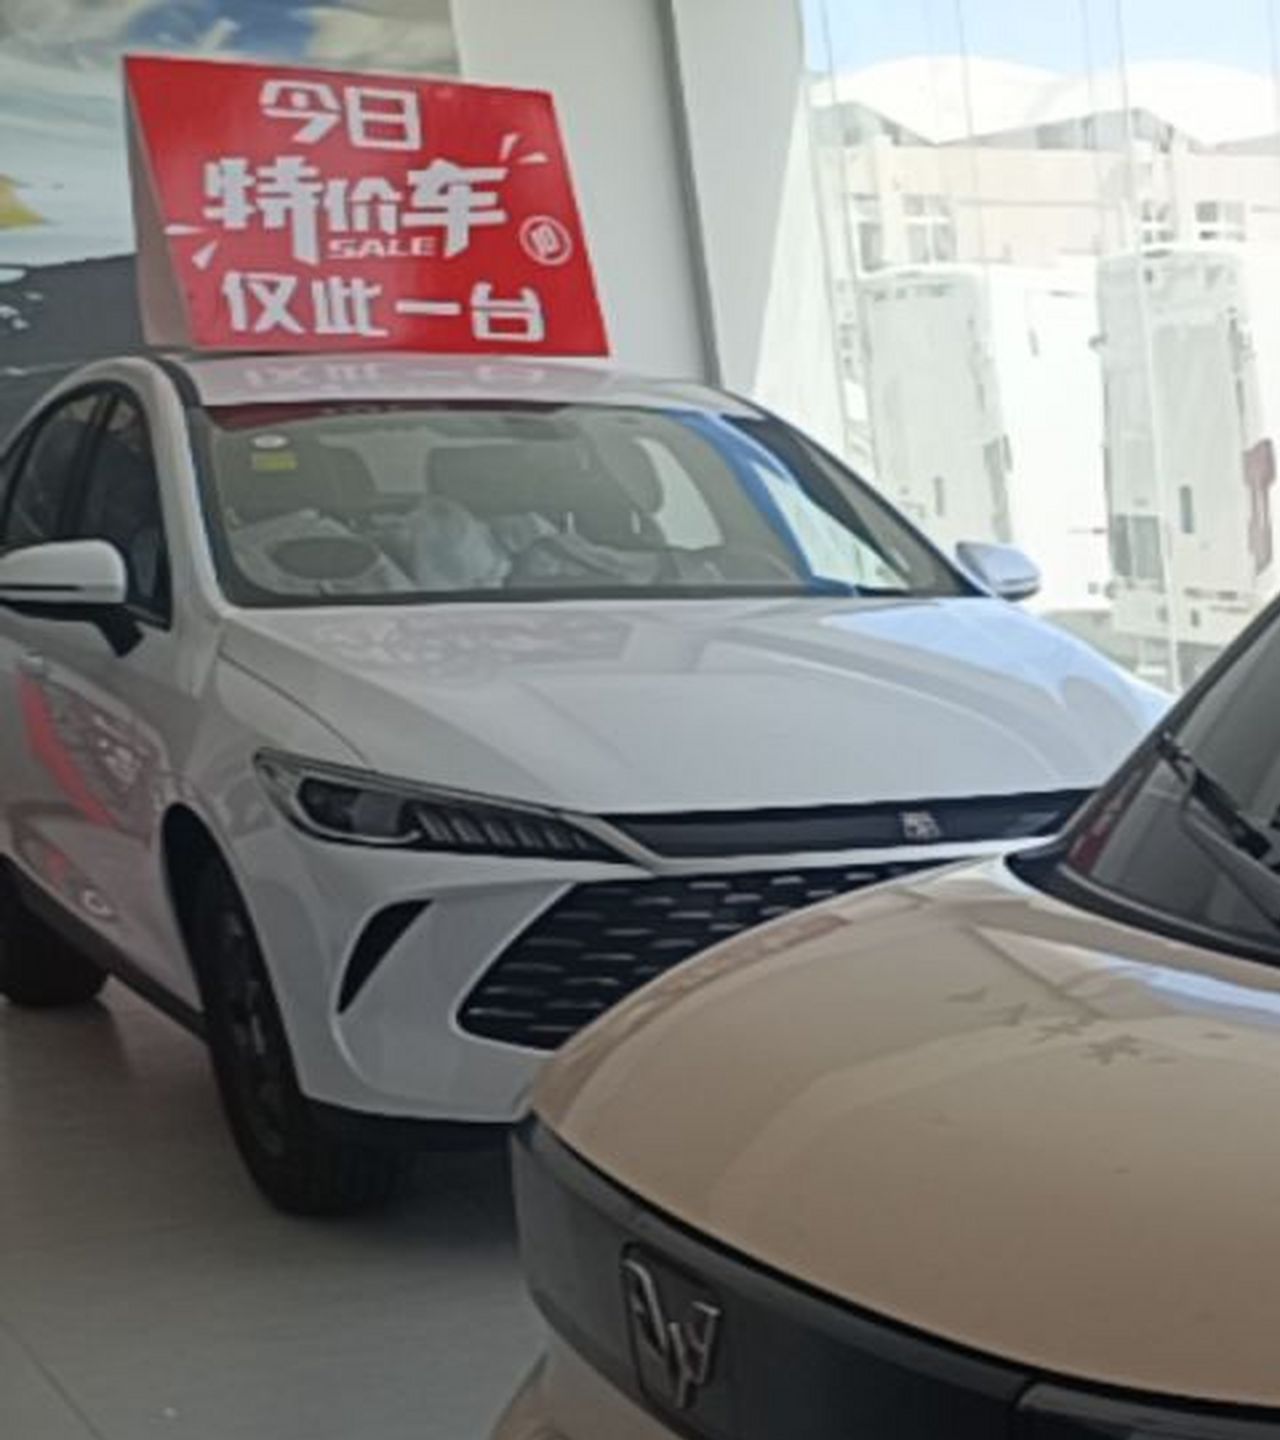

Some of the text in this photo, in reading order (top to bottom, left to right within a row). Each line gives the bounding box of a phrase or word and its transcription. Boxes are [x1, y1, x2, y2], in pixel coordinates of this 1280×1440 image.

[259, 78, 423, 151] 今日
[202, 155, 510, 265] 特价车
[327, 236, 437, 259] SALE
[221, 270, 547, 343] 仅此一台
